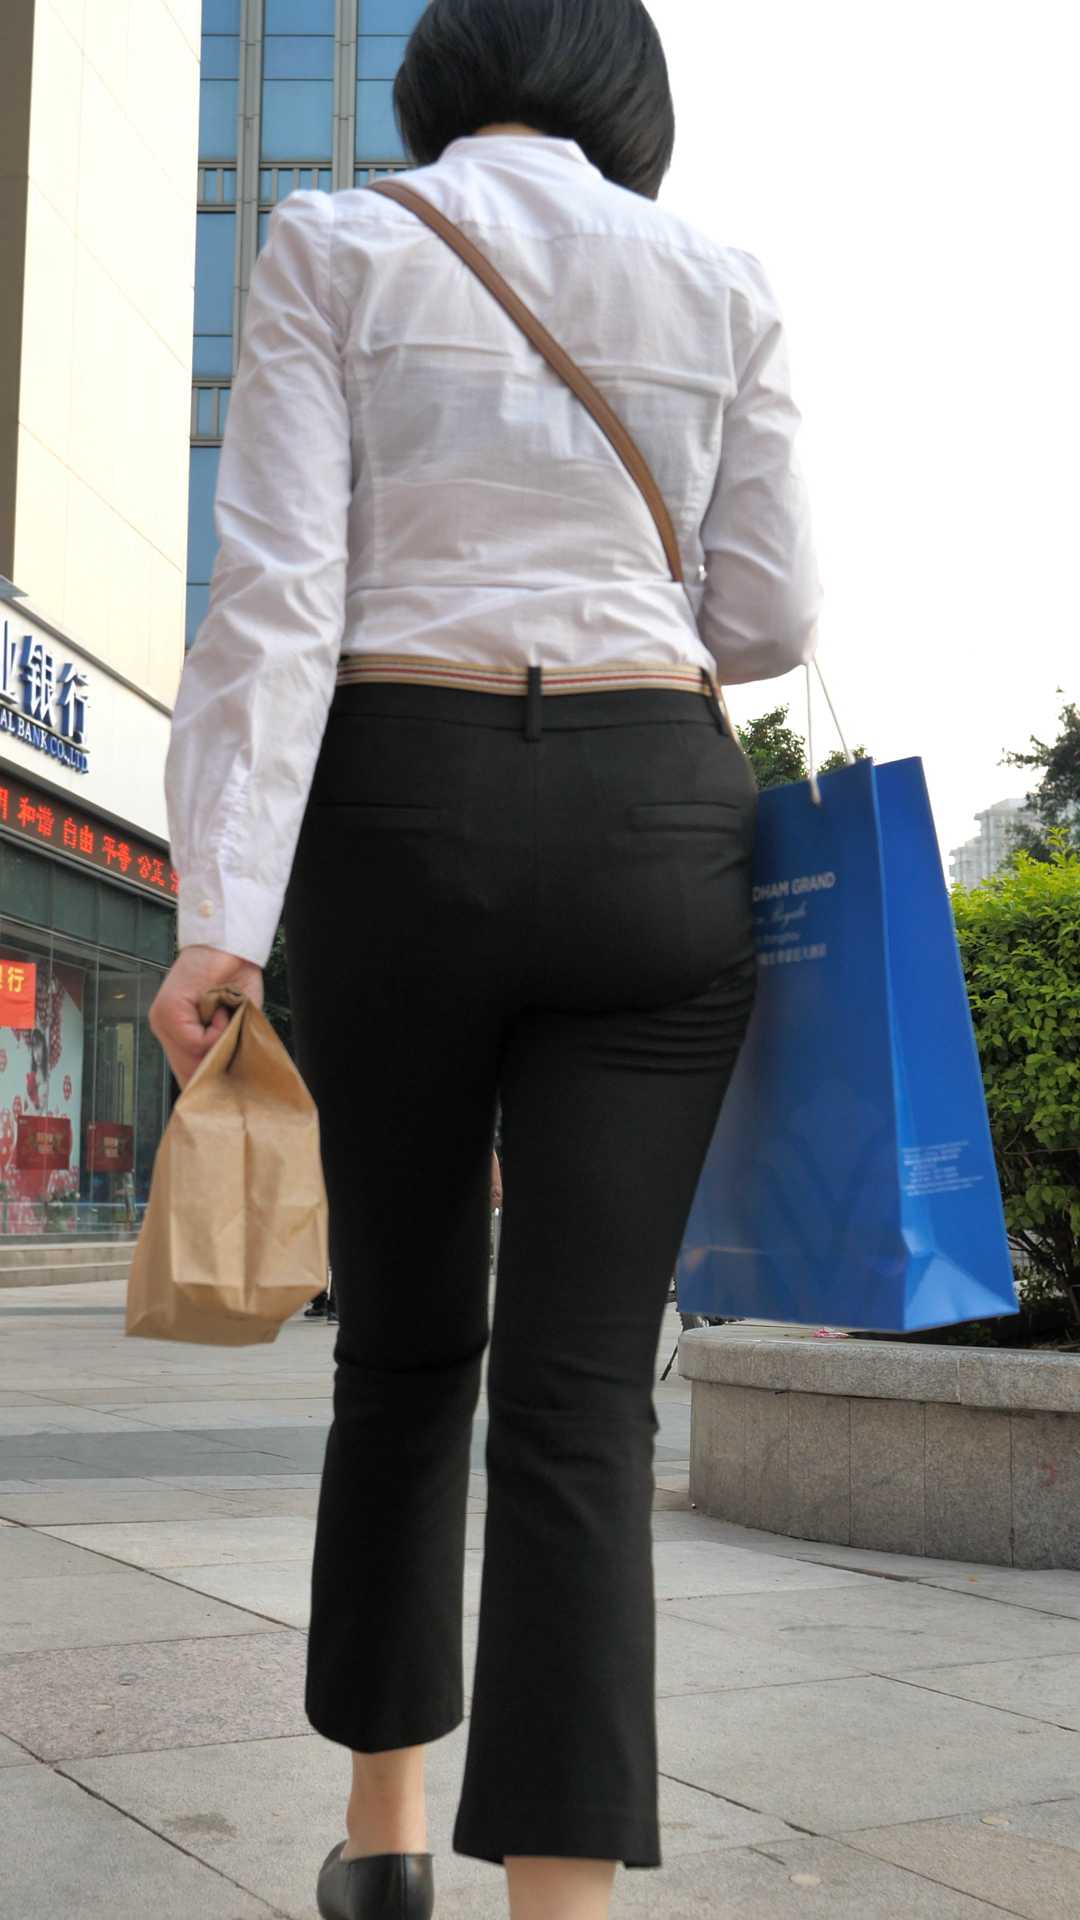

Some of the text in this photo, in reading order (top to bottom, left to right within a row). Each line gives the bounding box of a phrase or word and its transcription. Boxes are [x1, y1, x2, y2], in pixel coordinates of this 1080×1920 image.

[17, 716, 49, 750] BANK
[17, 796, 55, 838] 和谐
[63, 816, 94, 855] 自由
[102, 834, 132, 873] 平等
[791, 871, 837, 896] GRAND
